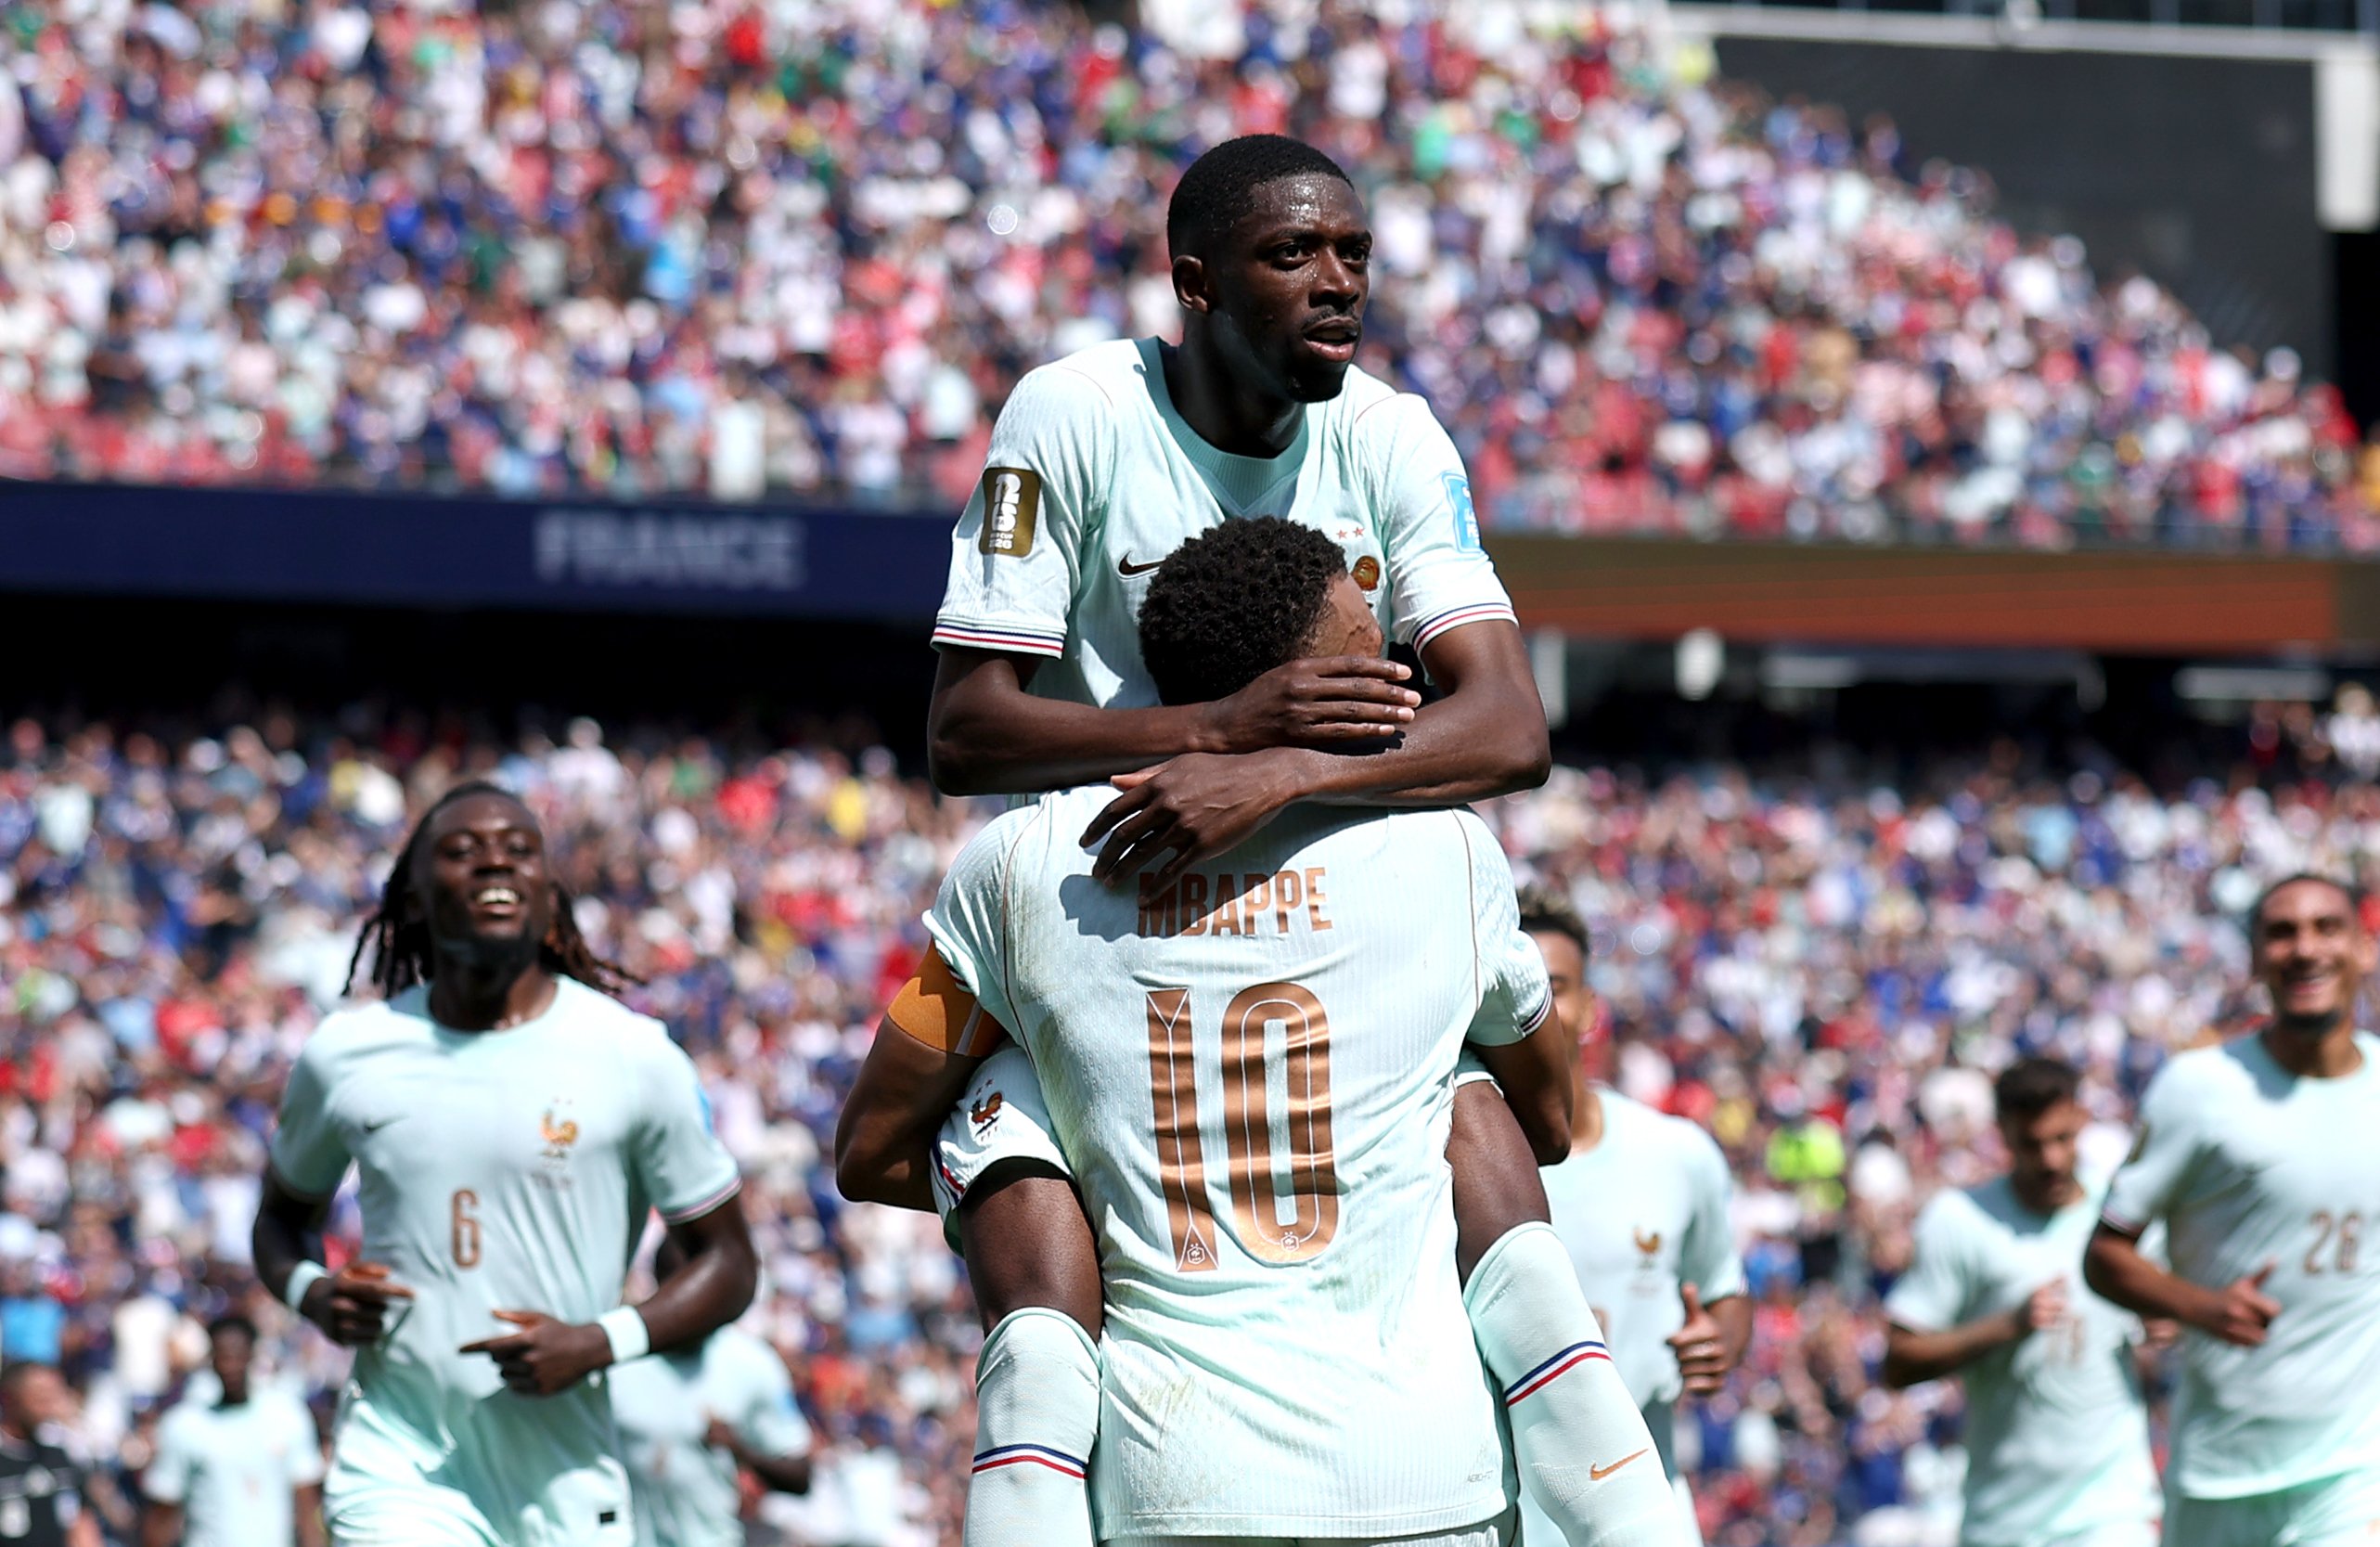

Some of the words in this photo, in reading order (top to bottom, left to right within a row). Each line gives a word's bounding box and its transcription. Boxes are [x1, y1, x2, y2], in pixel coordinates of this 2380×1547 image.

[535, 511, 804, 589] FRANCE
[1138, 867, 1332, 936] MBAPPE
[1146, 982, 1339, 1272] 10
[452, 1189, 482, 1270] 6
[2303, 1209, 2362, 1275] 26
